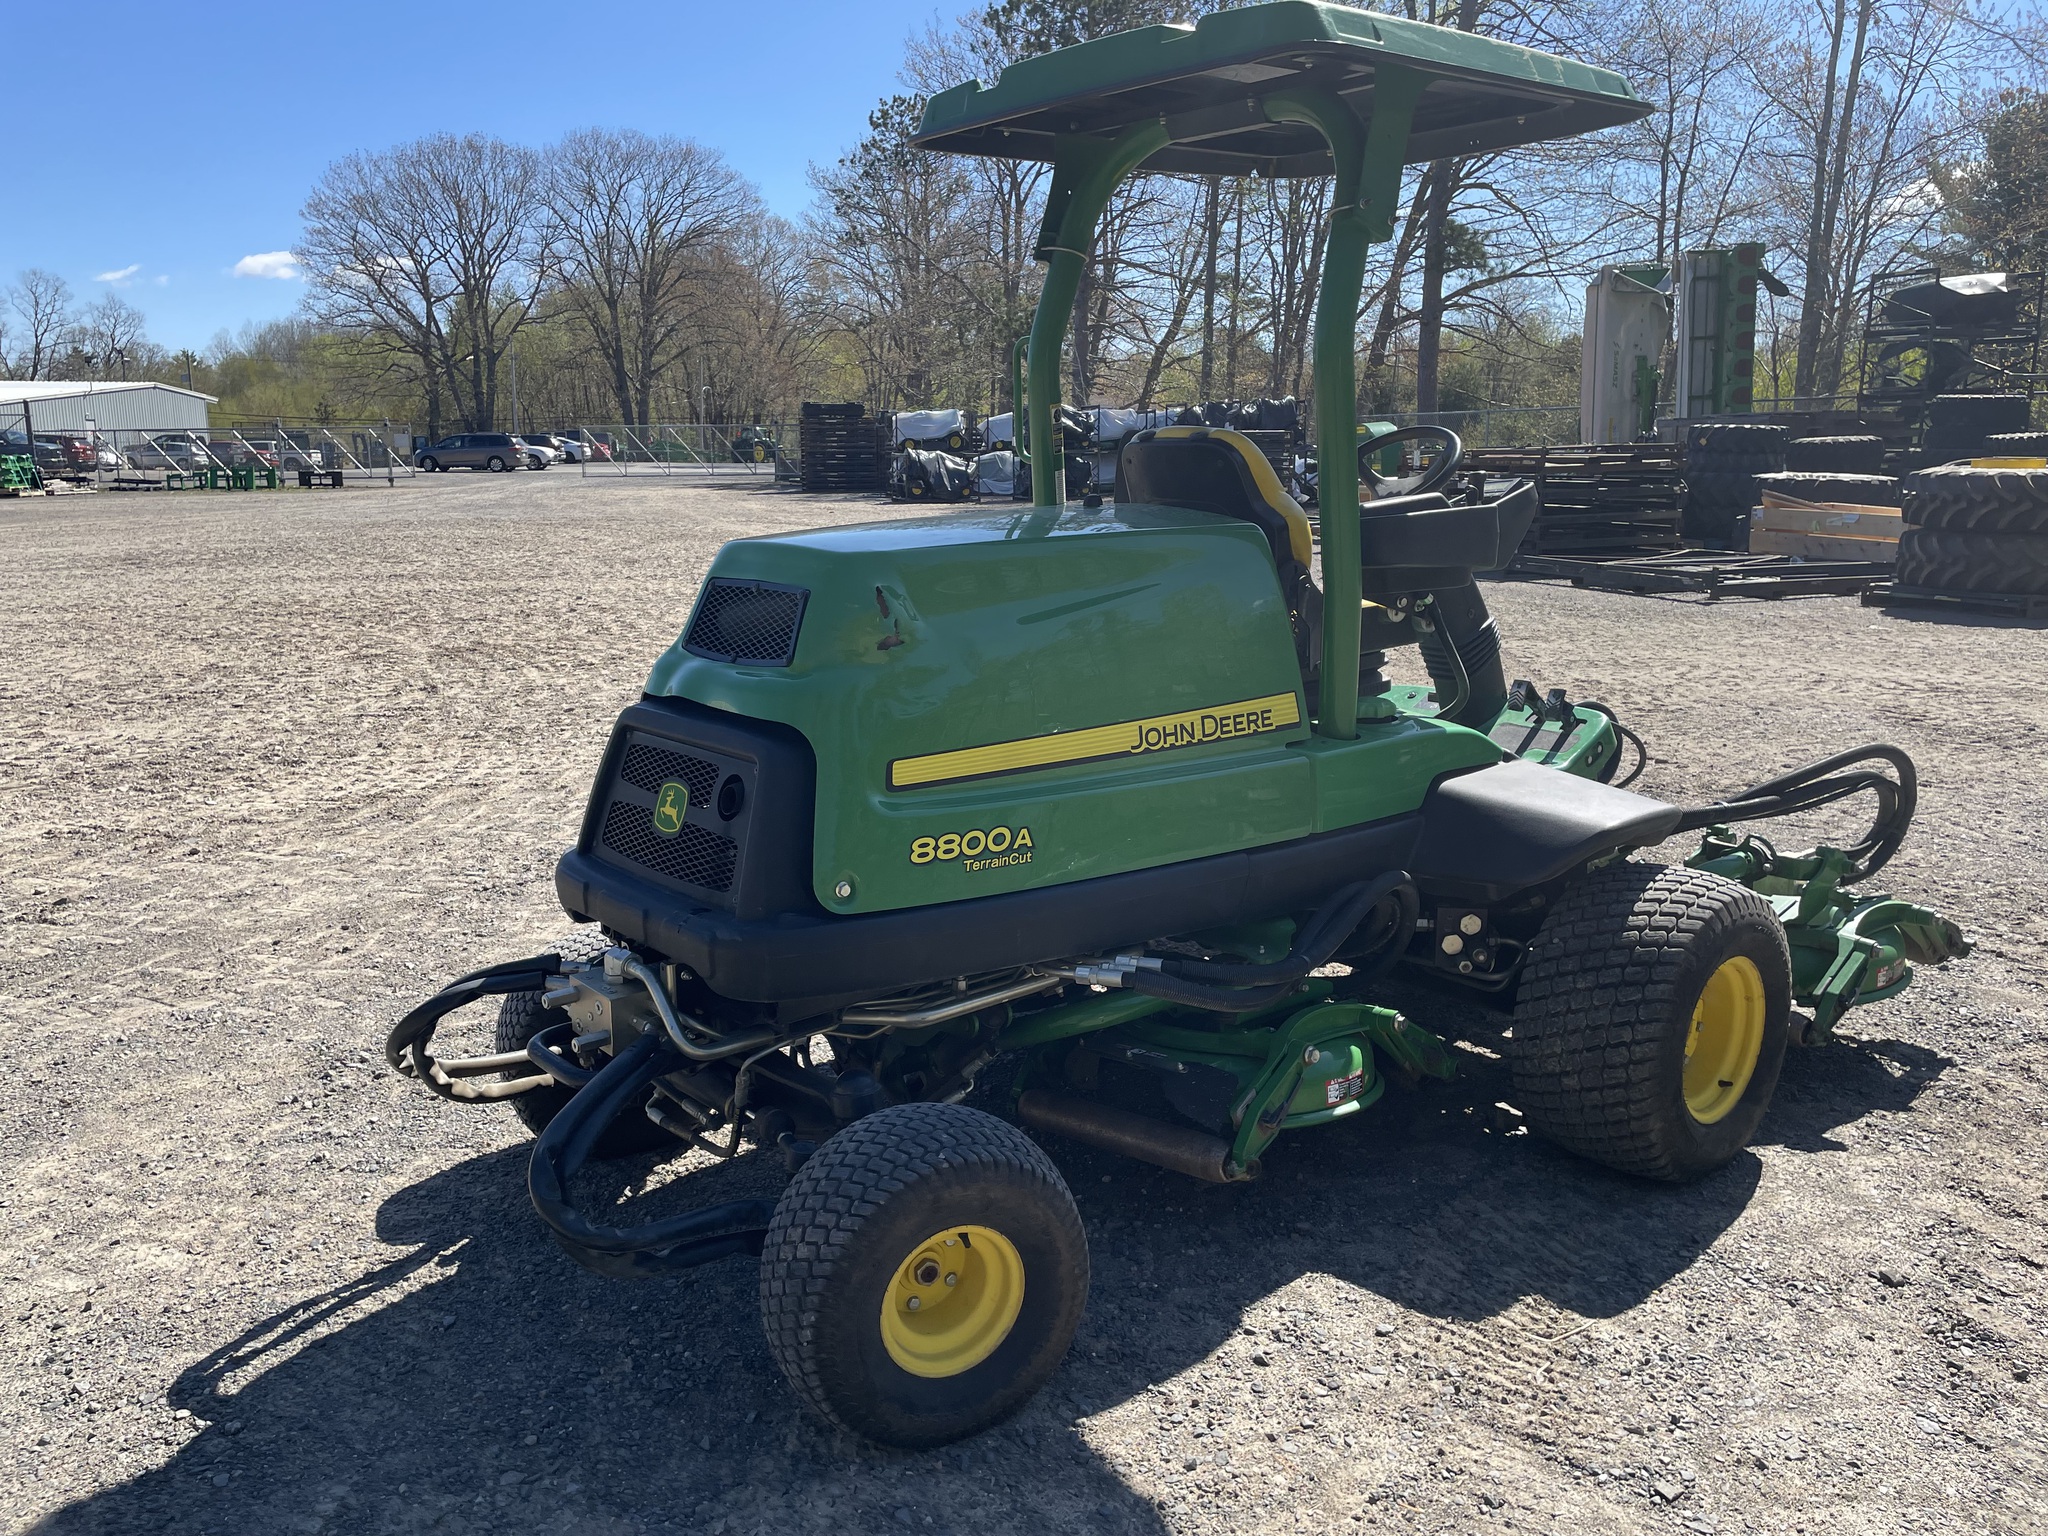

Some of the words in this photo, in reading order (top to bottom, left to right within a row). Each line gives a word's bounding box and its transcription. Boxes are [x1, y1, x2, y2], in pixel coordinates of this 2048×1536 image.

[1130, 721, 1196, 751] JOHN
[1200, 709, 1274, 739] DEERE
[909, 826, 1034, 864] 8800A
[963, 851, 1033, 872] TerrainCut
